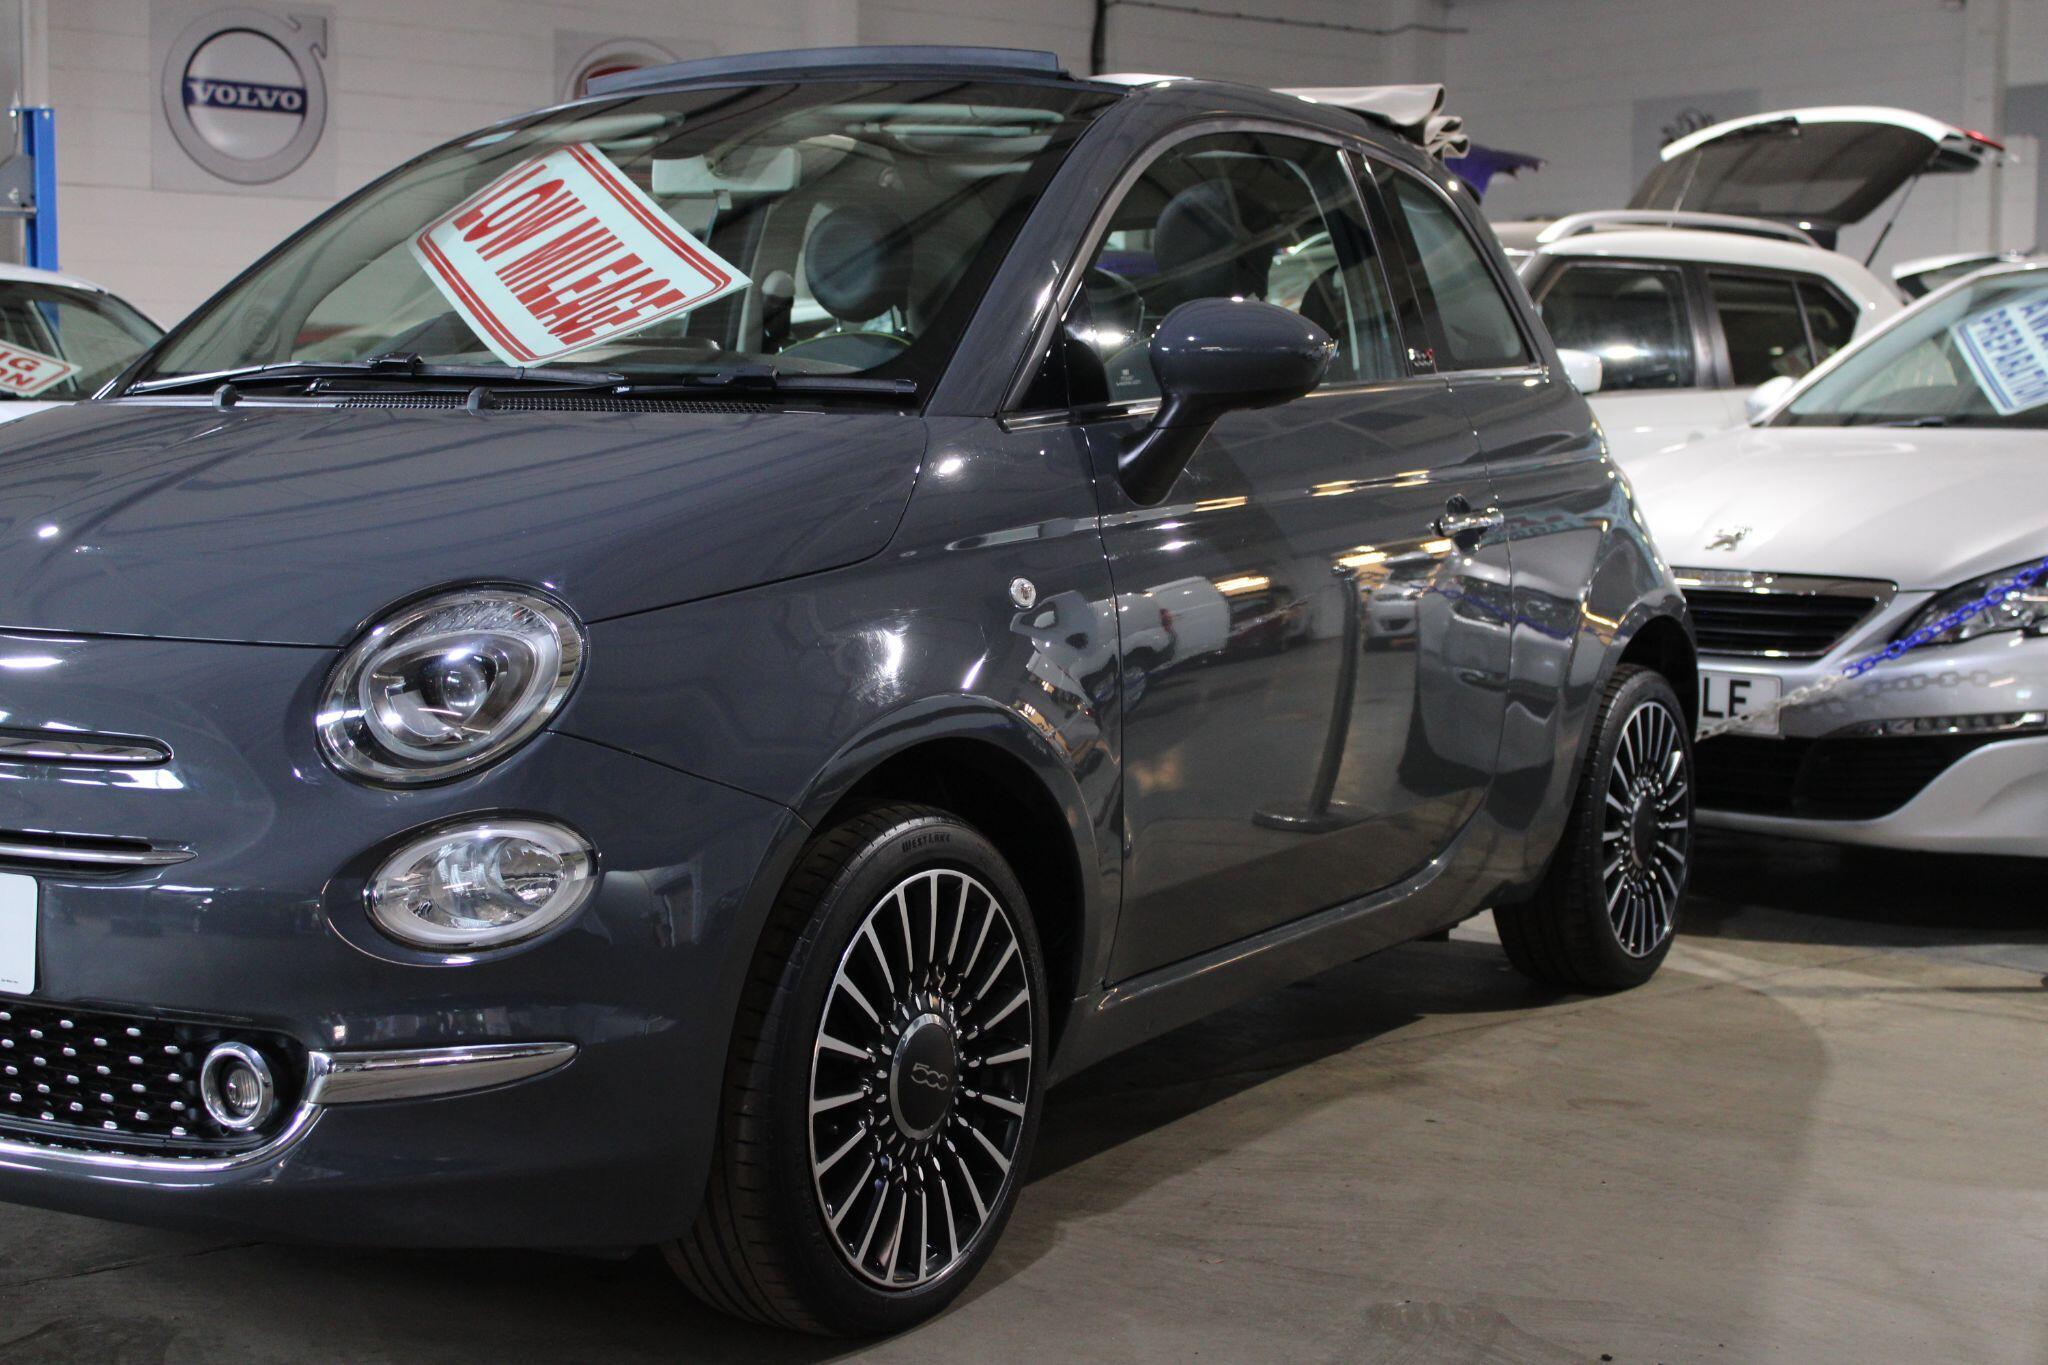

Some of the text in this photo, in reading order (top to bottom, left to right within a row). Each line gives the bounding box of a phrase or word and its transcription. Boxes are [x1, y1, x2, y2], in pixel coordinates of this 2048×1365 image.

[187, 81, 302, 111] VOLVO
[452, 164, 688, 346] LOW MILEAGE
